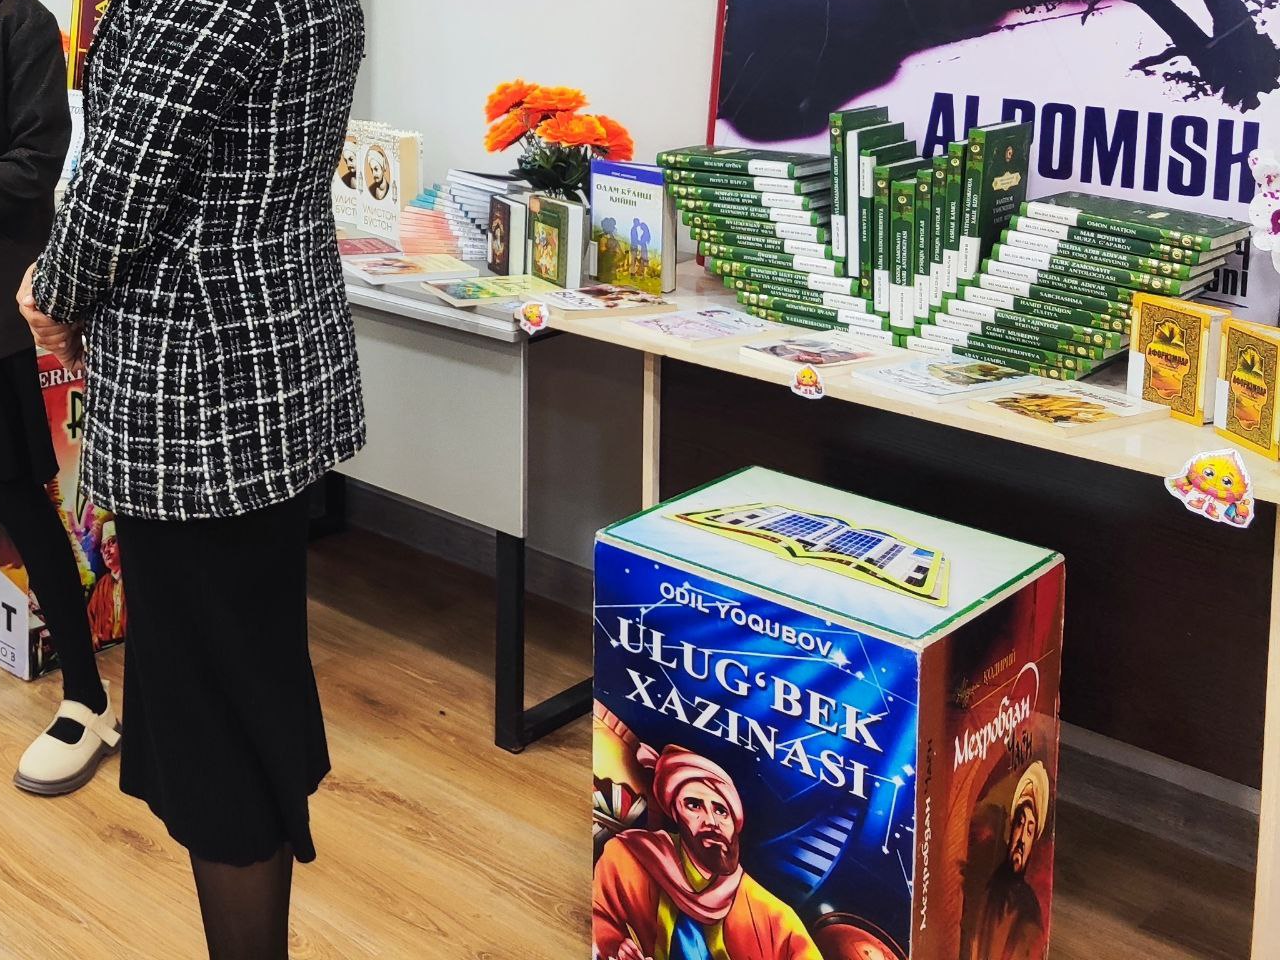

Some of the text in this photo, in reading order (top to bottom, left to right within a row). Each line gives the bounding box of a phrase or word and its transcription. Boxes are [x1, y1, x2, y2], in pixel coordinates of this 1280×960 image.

[1086, 220, 1108, 229] OMON
[660, 582, 833, 657] ODIL YOQUBOV
[626, 668, 868, 799] XAZINASI
